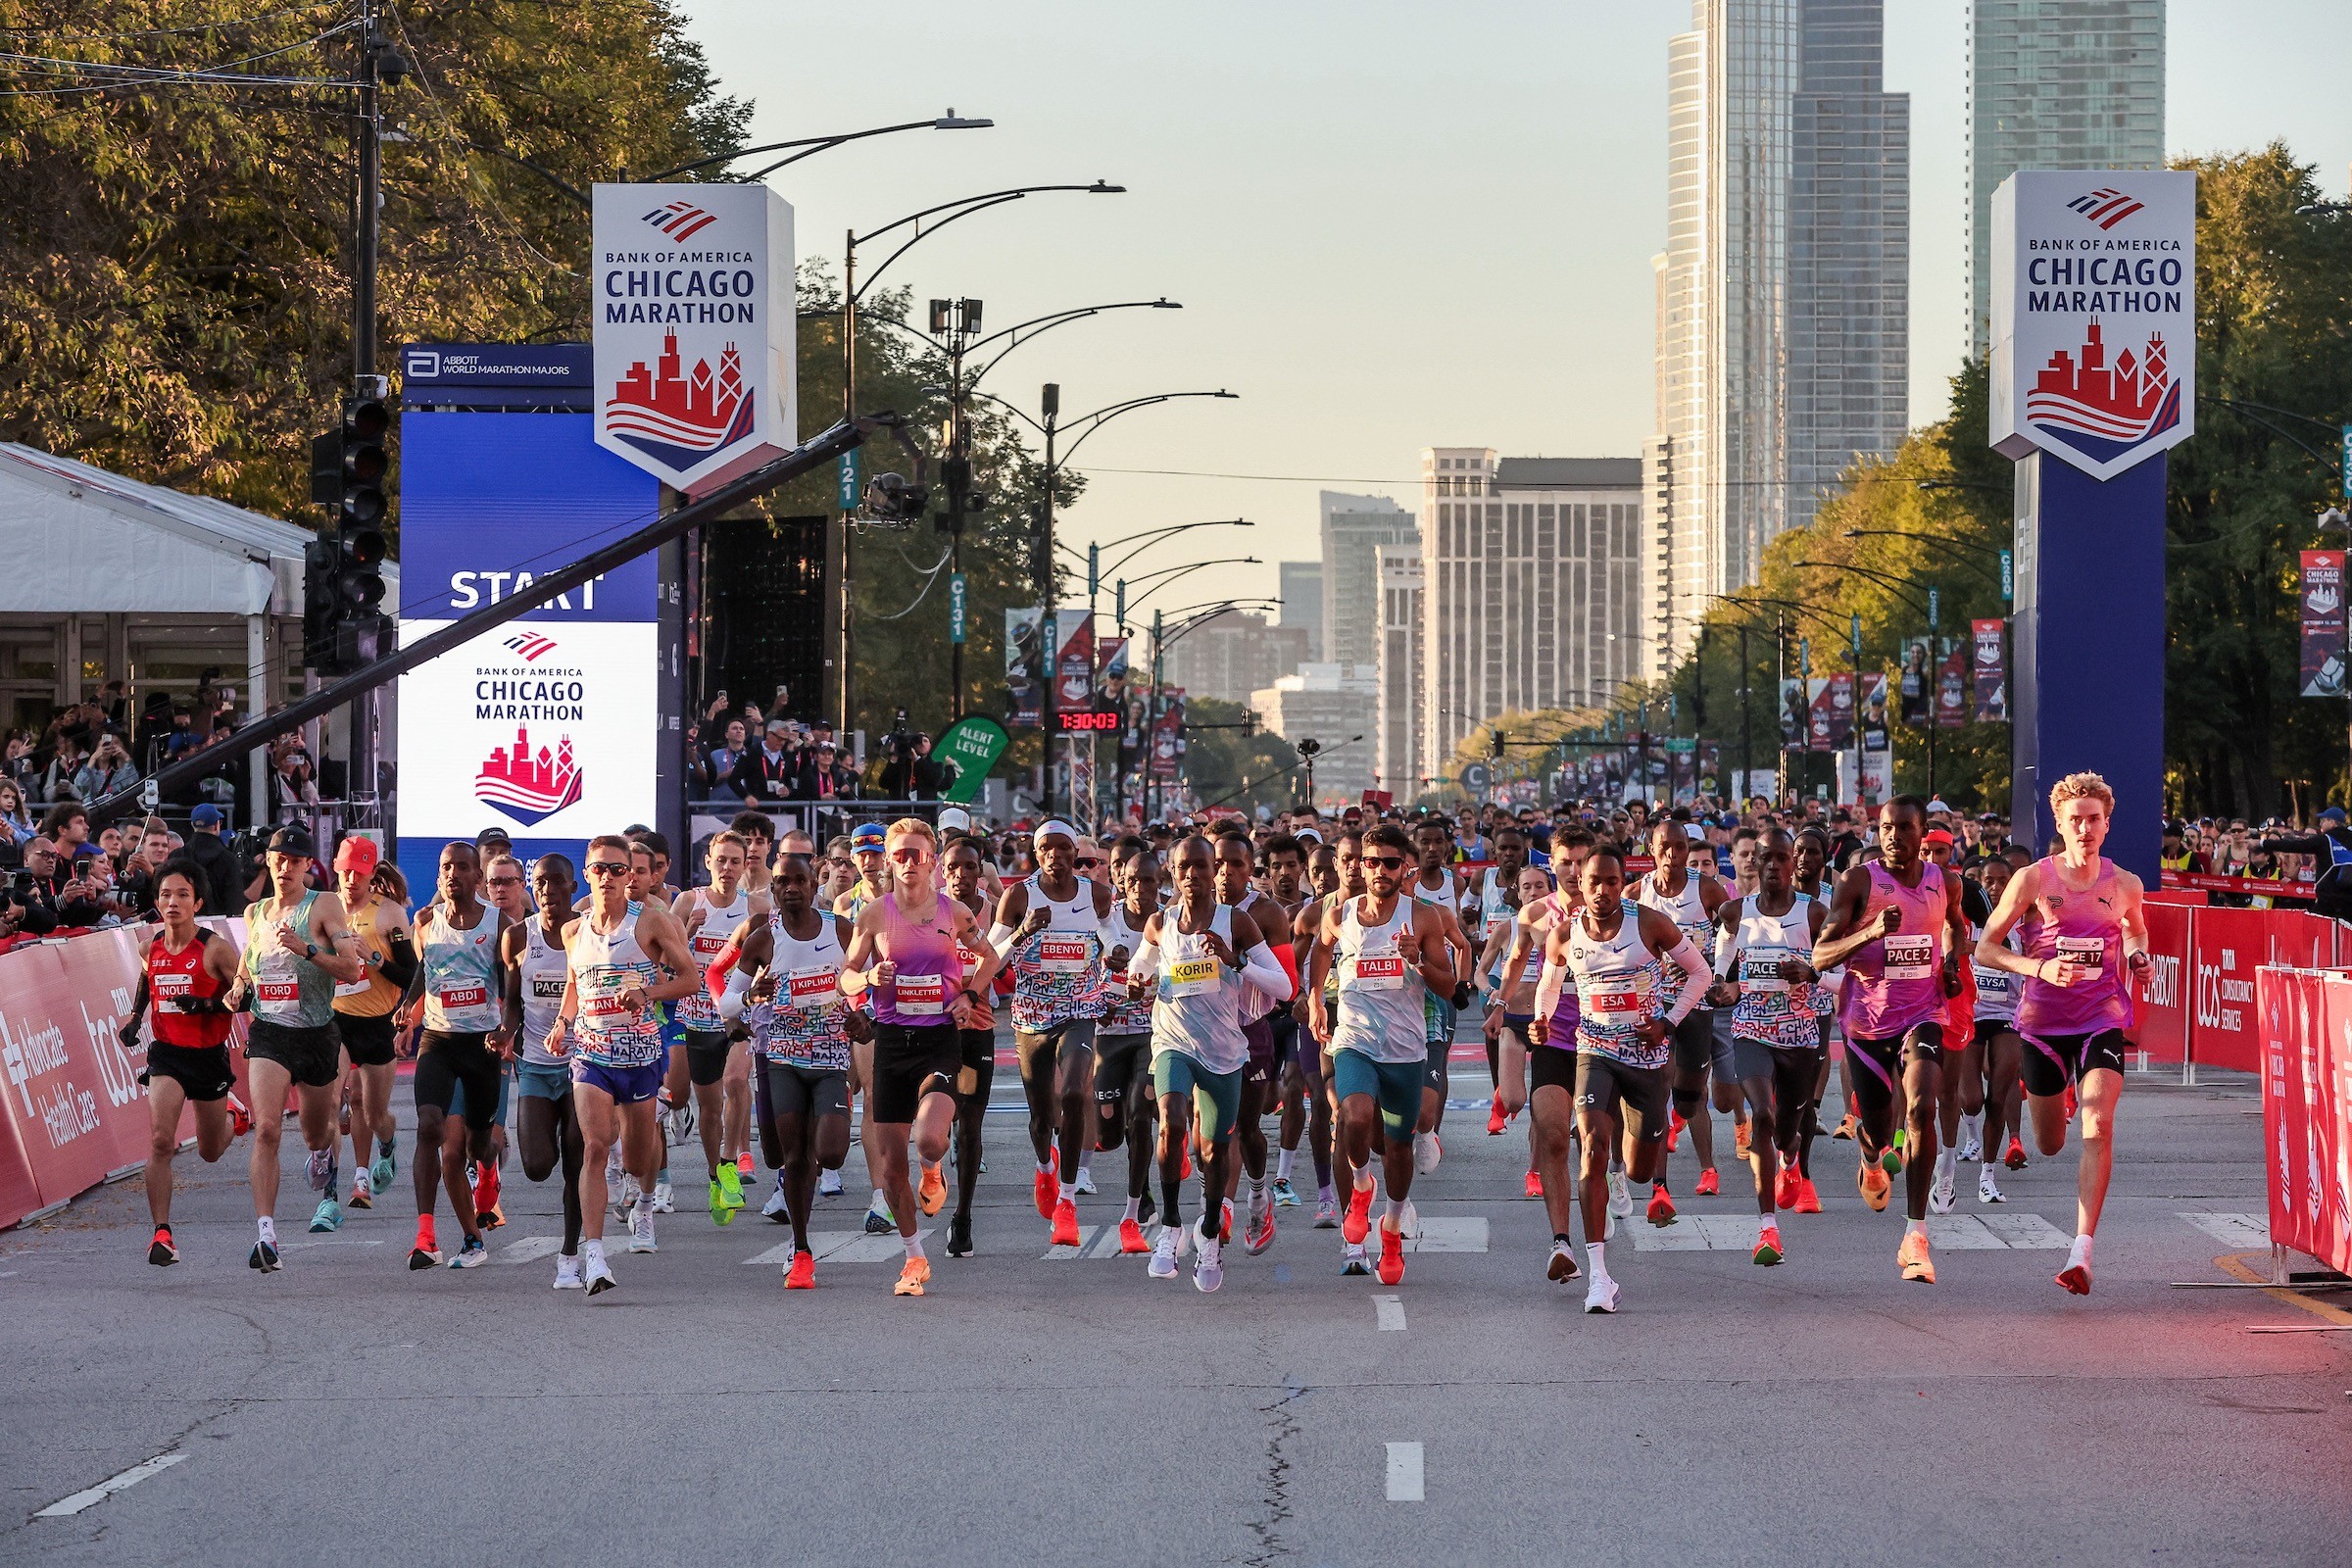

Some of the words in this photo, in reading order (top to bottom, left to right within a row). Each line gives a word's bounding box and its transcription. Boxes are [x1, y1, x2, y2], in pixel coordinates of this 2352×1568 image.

[2030, 239, 2075, 250] BANK
[2080, 239, 2100, 250] OF
[2105, 240, 2180, 251] AMERICA
[606, 252, 650, 263] BANK
[655, 252, 675, 263] OF
[679, 252, 753, 263] AMERICA
[2029, 258, 2182, 285] CHICAGO
[606, 270, 754, 297] CHICAGO
[2029, 291, 2180, 313] MARATHON
[606, 303, 754, 323] MARATHON
[443, 356, 479, 366] ABBOTT
[478, 366, 531, 374] MARATHON
[532, 366, 569, 375] MAJORS
[842, 452, 855, 500] 121
[951, 579, 964, 636] C131
[1044, 625, 1054, 671] C141
[512, 667, 526, 676] OF
[476, 681, 583, 701] CHICAGO
[476, 705, 583, 720] MARATHON
[959, 726, 995, 745] ALERT
[956, 740, 990, 759] LEVEL
[1042, 944, 1084, 955] EBENYO
[1886, 949, 1921, 961] PACE
[1923, 948, 1931, 960] 2
[2089, 952, 2102, 962] 17
[2222, 948, 2236, 971] TATA
[1175, 962, 1213, 977] KORIR
[1361, 960, 1396, 972] TALBI
[1747, 962, 1777, 975] PACE
[535, 981, 565, 993] PACE
[798, 976, 834, 990] KIPLIMO
[1975, 976, 2006, 988] FEYSA
[2150, 954, 2180, 1008] ABBOTT
[159, 985, 190, 996] INOUE
[264, 985, 292, 996] FORD
[450, 990, 478, 1003] ABDI
[897, 988, 942, 997] LINKLETTER
[2222, 978, 2254, 1004] CONSULTANCY
[588, 999, 617, 1011] MANT
[1600, 996, 1626, 1006] ESA
[2222, 1007, 2242, 1032] SERVICES
[18, 1017, 69, 1078] Advocate
[37, 1082, 79, 1149] Health
[67, 1081, 101, 1135] Care
